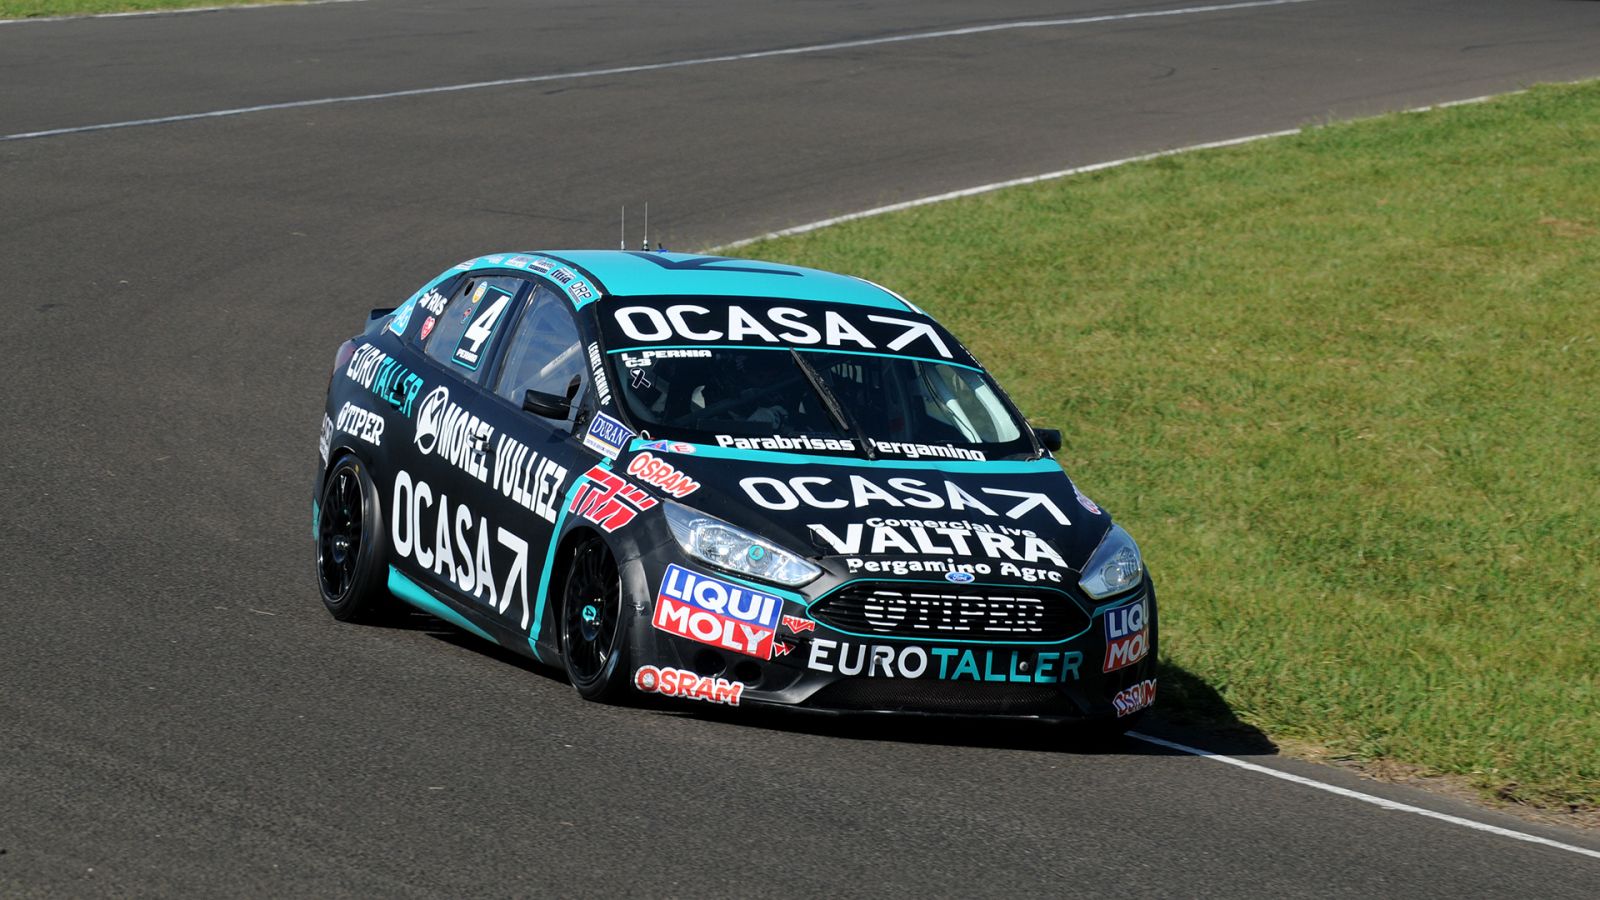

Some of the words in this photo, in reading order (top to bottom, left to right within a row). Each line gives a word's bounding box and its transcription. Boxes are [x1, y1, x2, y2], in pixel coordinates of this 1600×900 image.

[464, 295, 511, 353] 4
[614, 304, 877, 349] OCASA
[588, 341, 602, 371] LEONEL
[642, 350, 713, 359] PERNIA
[594, 367, 610, 399] PERNIA
[591, 416, 629, 446] DURAN
[716, 434, 855, 453] Parabrisas
[866, 437, 987, 462] ergamino
[493, 433, 568, 524] VULLIEZ
[628, 452, 700, 497] OSRAM
[738, 475, 1000, 516] OCASA
[391, 470, 498, 605] OCASA
[806, 523, 1069, 568] VALTRA
[866, 518, 993, 533] Comercial
[846, 558, 992, 575] Pergamino
[662, 568, 775, 626] LIQUI
[658, 601, 773, 654] MOLY
[782, 615, 815, 634] RIVA
[1108, 599, 1149, 639] LIQU
[808, 640, 1083, 683] EUROTALLER
[1107, 629, 1149, 670] MOL
[635, 665, 744, 706] OSRAM
[1112, 678, 1157, 718] OSRAM
